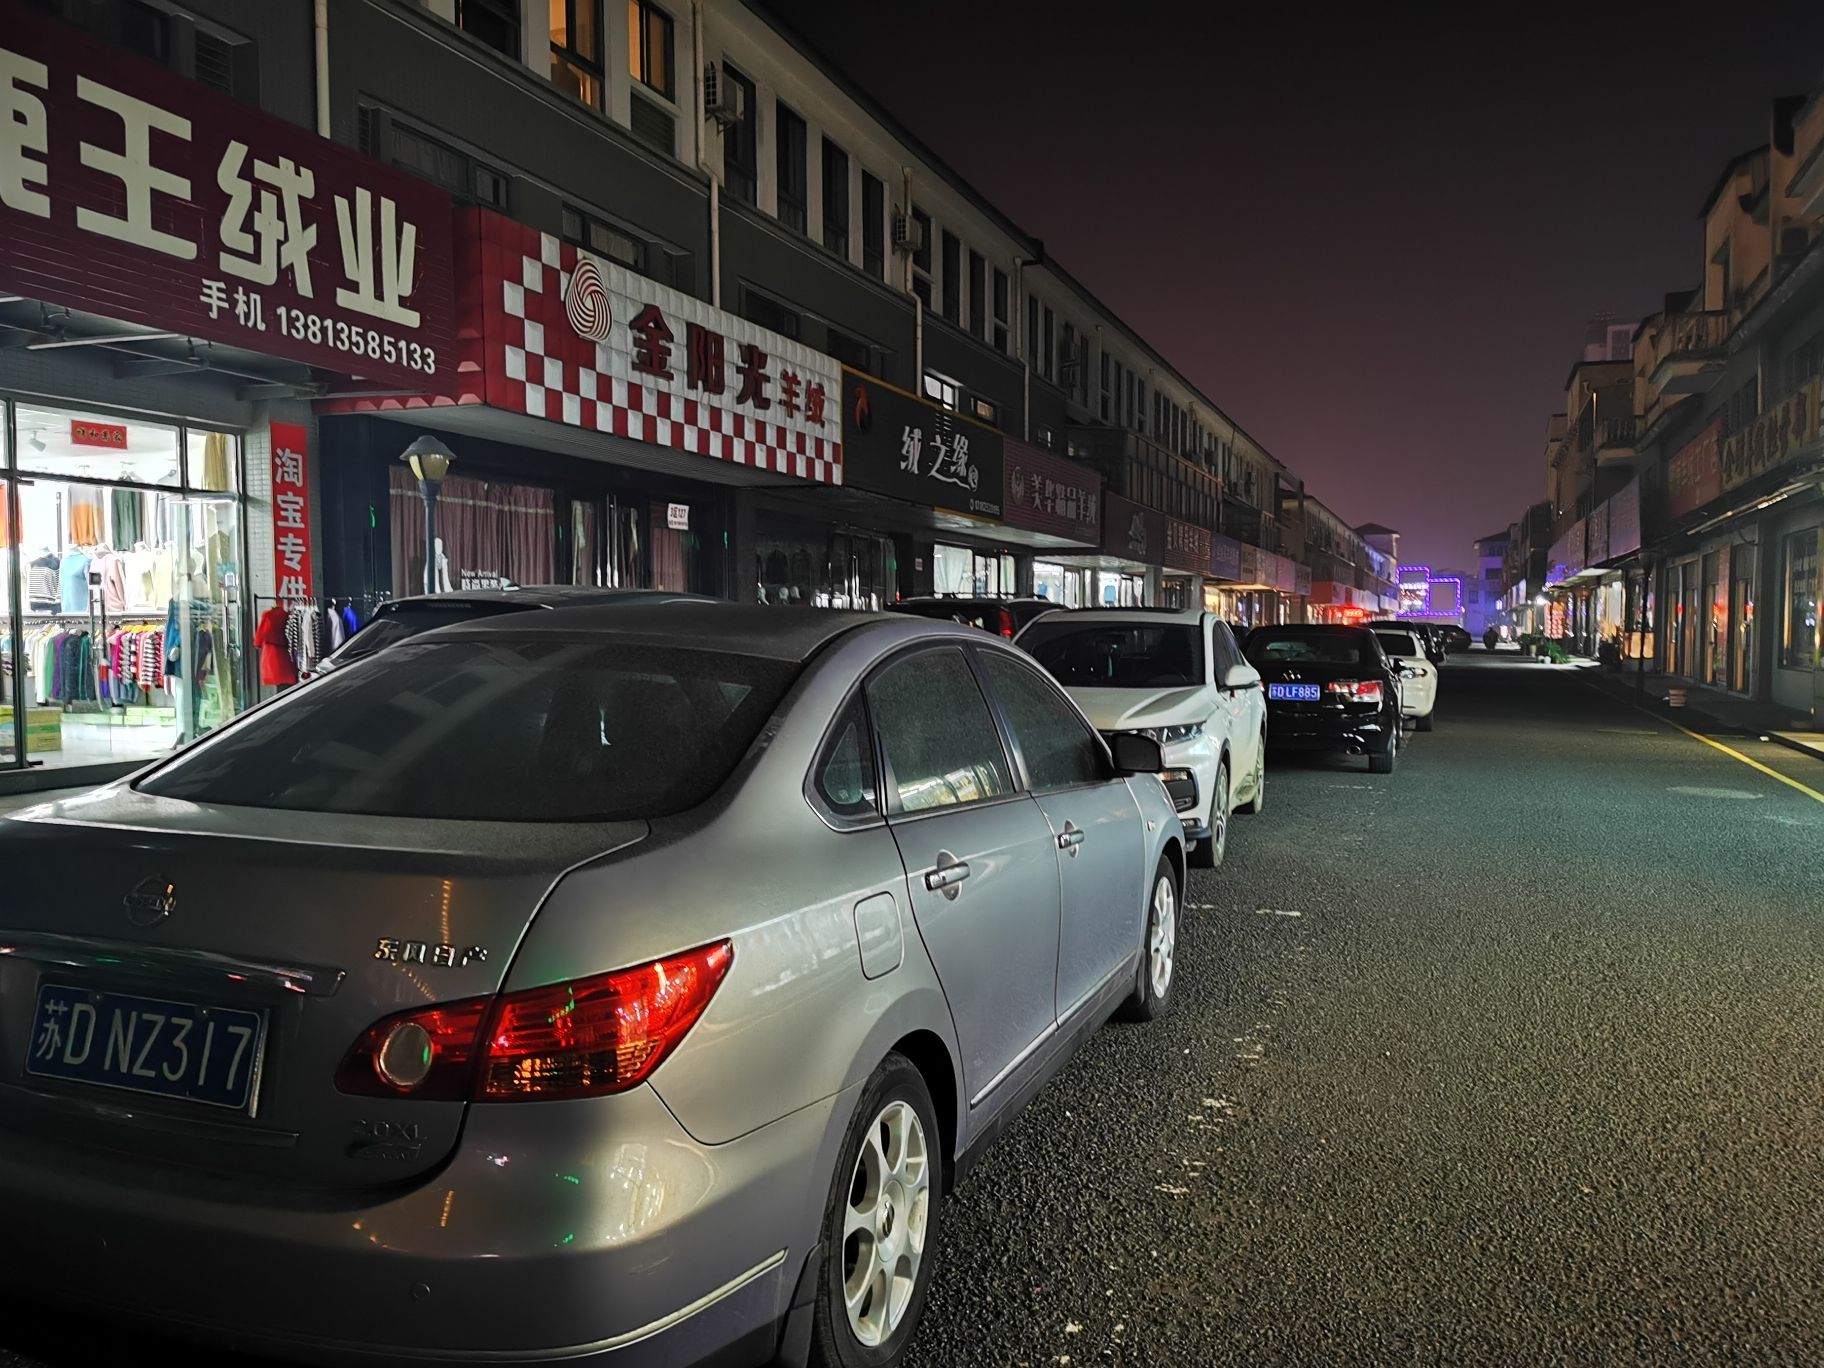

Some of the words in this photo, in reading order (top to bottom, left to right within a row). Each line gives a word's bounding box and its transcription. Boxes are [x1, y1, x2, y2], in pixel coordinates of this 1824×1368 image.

[199, 278, 266, 332] 手机
[276, 306, 436, 374] 13813585133
[275, 448, 306, 611] 淘宝专供
[461, 568, 475, 578] New
[373, 937, 488, 967] 东风日产
